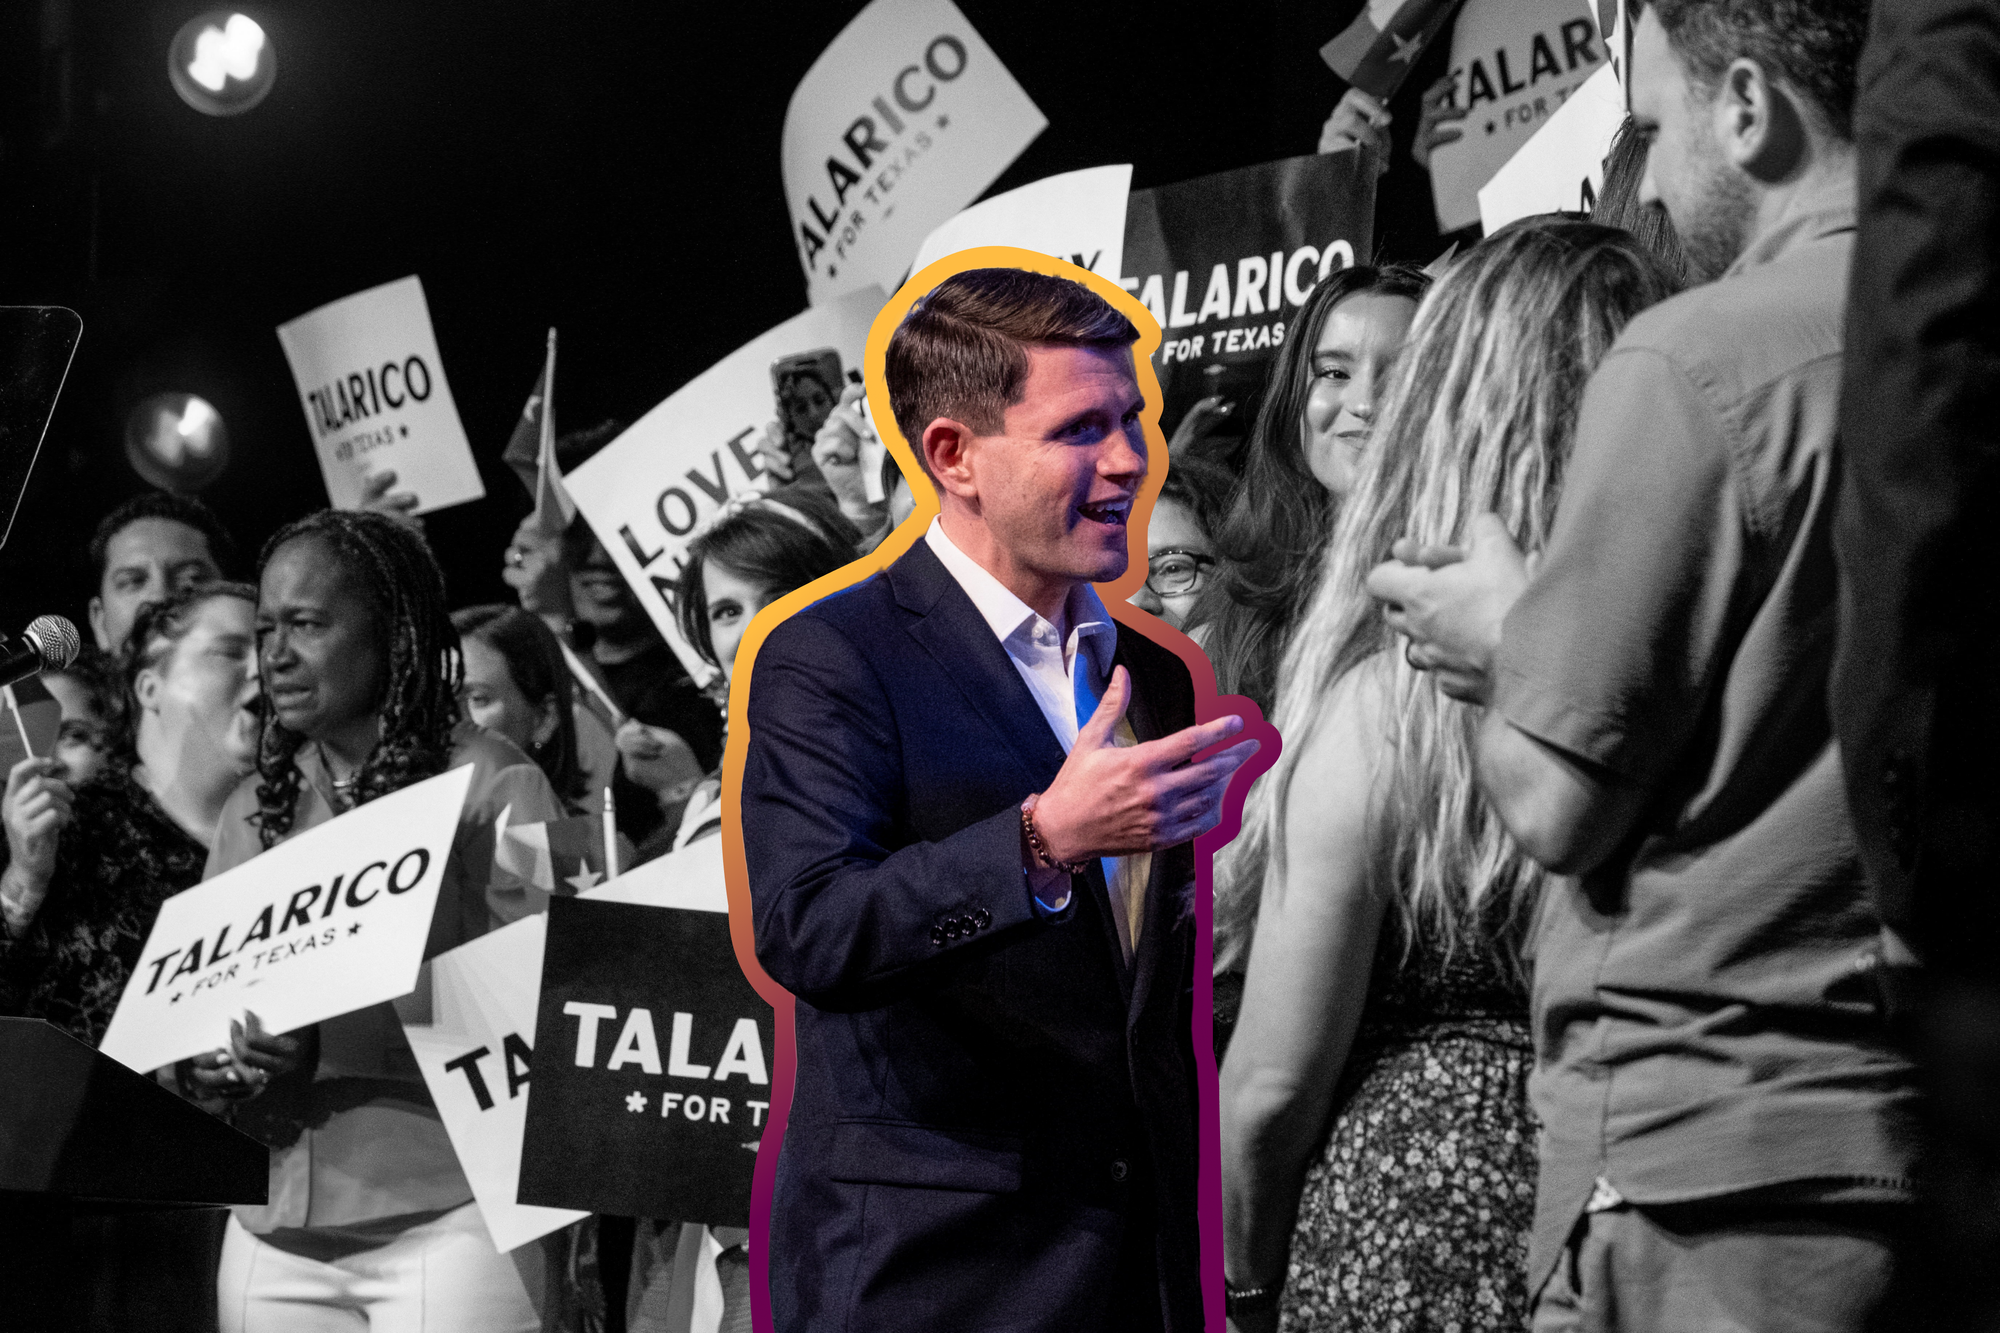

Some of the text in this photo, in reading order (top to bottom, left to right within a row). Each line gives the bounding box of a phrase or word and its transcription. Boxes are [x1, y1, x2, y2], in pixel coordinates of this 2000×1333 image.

[863, 130, 933, 205] TEXAS
[1162, 322, 1286, 365] FOR TEXAS
[308, 354, 431, 438] TALARICO
[619, 426, 766, 570] LOVE
[145, 848, 430, 996] TALARICO
[191, 927, 336, 997] FOR TEXAS
[661, 1092, 731, 1124] FOR
